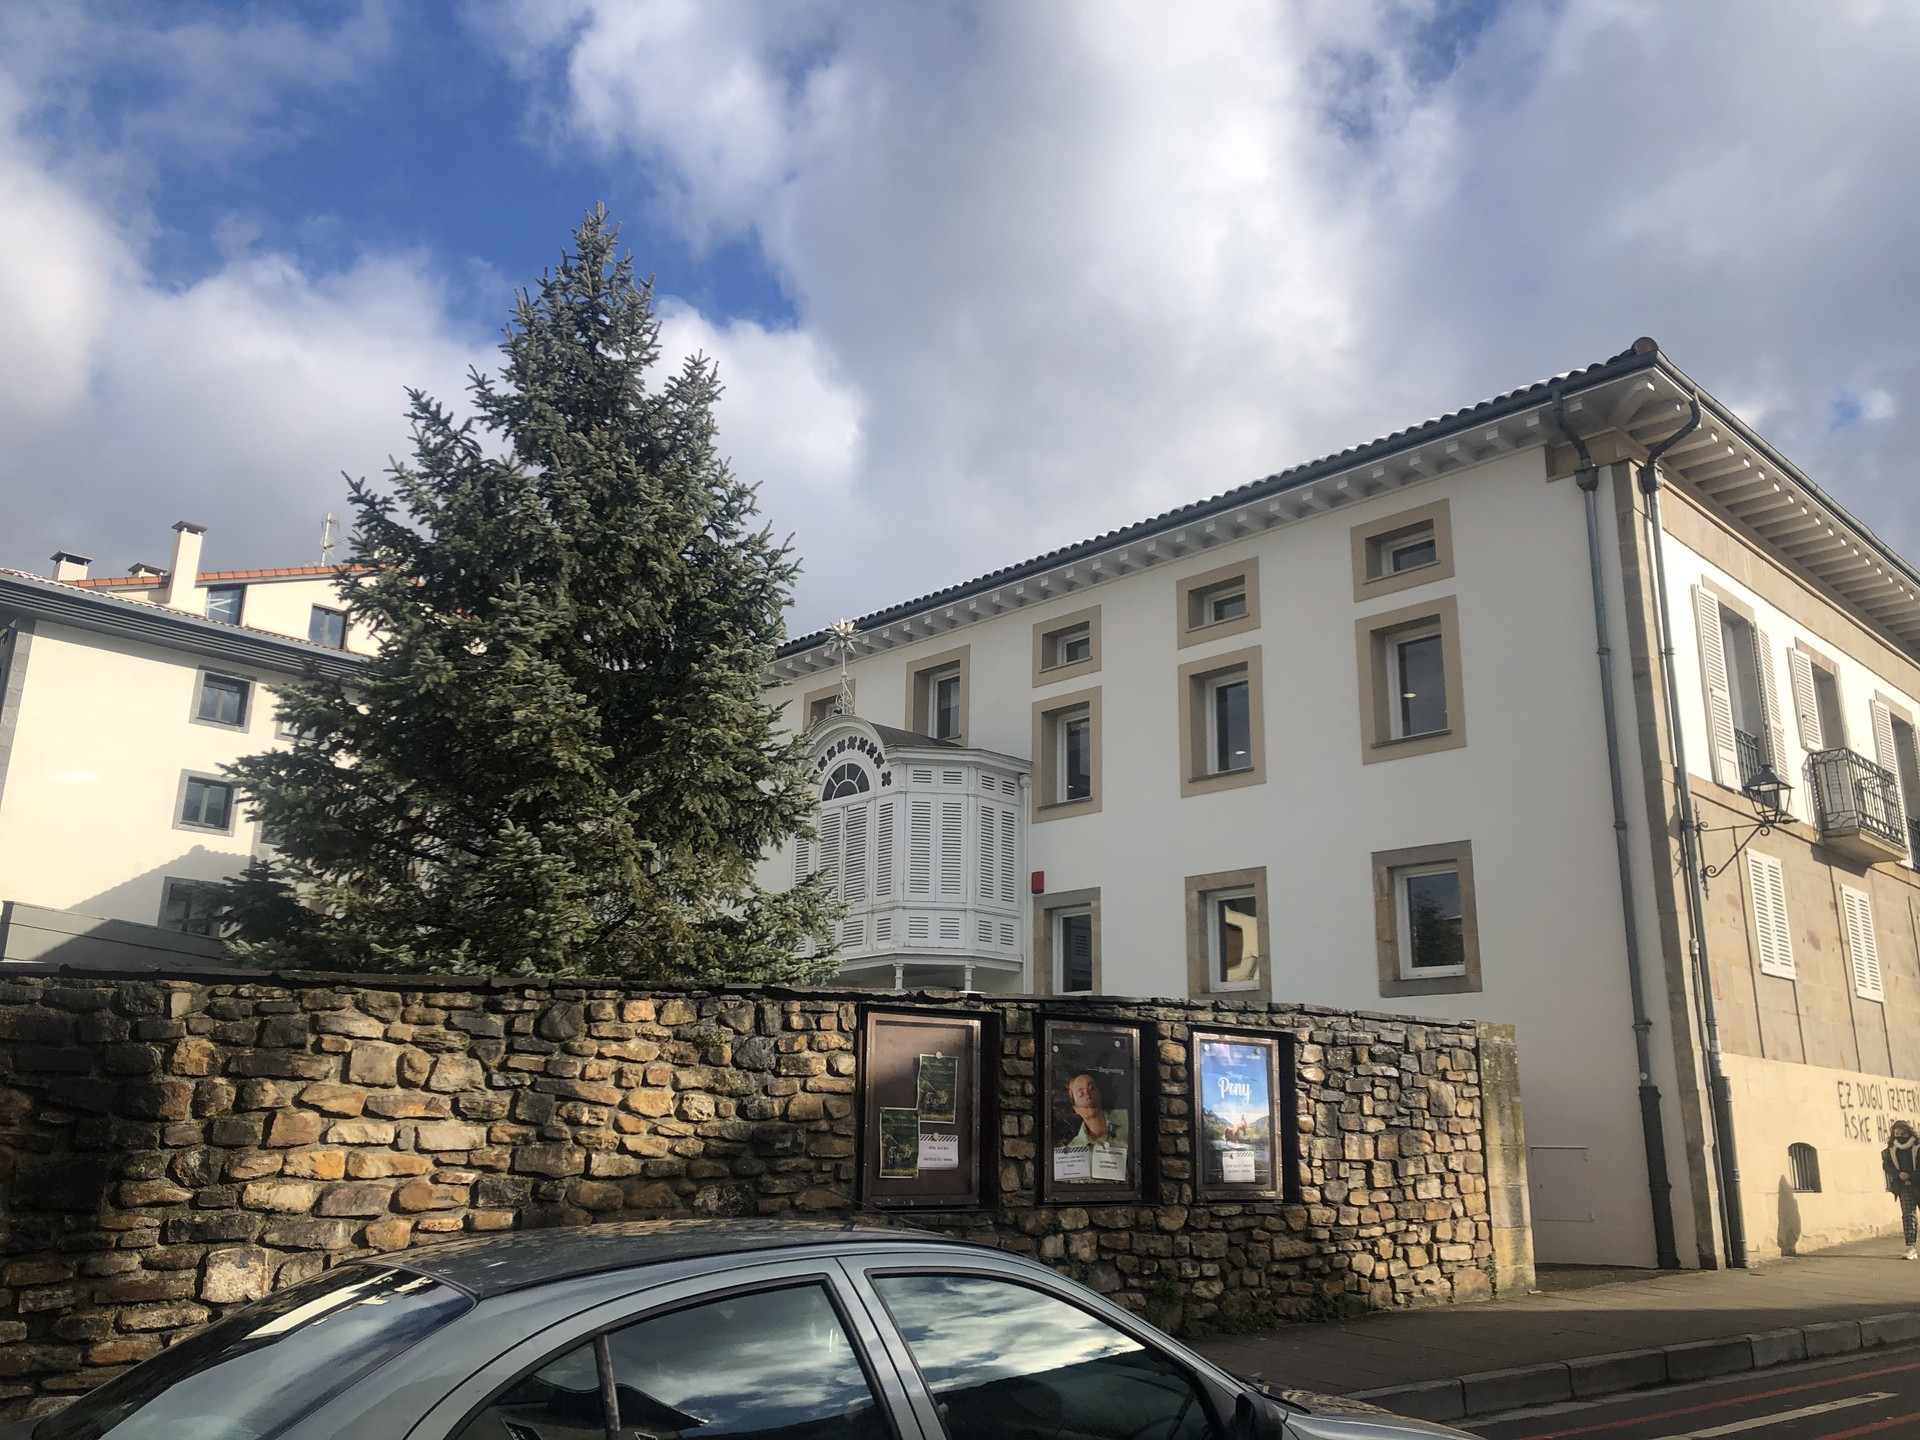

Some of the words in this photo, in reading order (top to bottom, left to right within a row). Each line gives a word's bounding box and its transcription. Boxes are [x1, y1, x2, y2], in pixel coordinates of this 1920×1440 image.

[1099, 1065, 1125, 1076] Beginning
[1217, 1076, 1252, 1106] Pony
[1837, 1080, 1854, 1110] EZ
[1856, 1081, 1883, 1110] DUGU
[1843, 1111, 1872, 1143] ASKE
